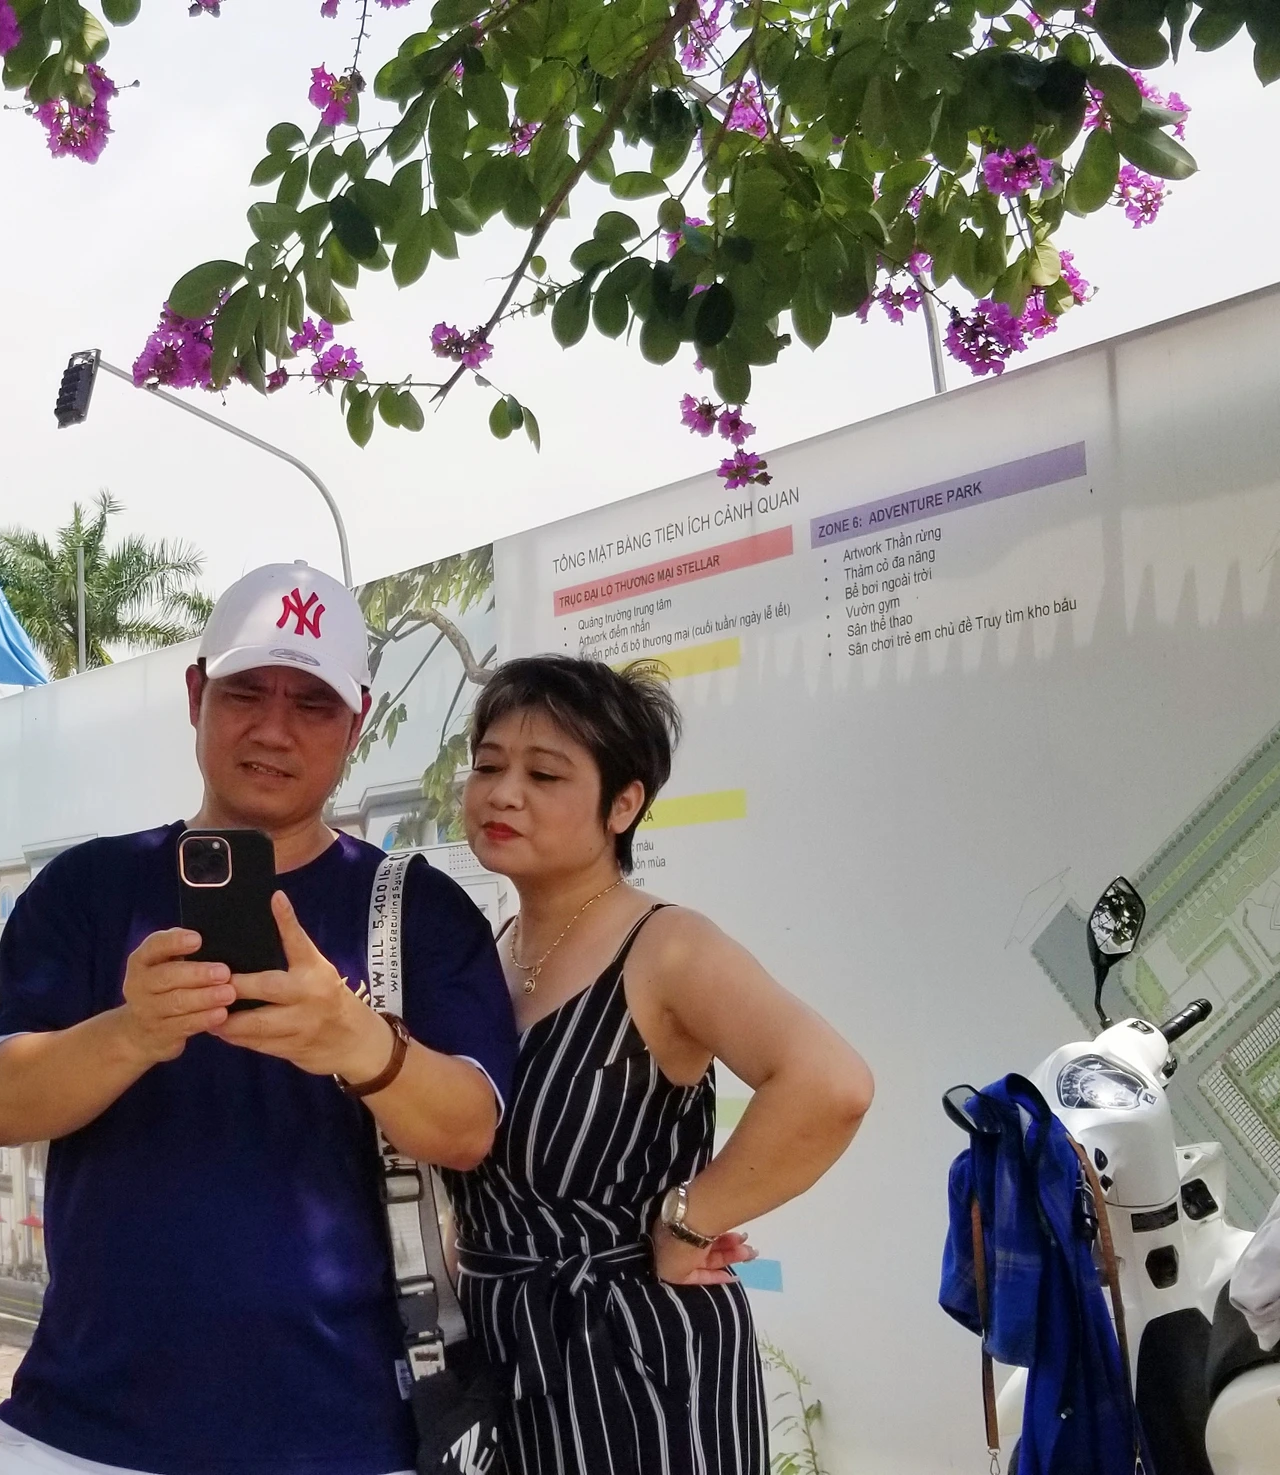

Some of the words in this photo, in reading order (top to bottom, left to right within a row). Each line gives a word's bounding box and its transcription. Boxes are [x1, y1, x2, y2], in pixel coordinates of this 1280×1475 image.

[654, 522, 684, 544] TIỆN
[688, 514, 710, 535] ÍCH
[714, 501, 753, 526] CẢNH
[757, 487, 799, 514] QUAN
[818, 518, 850, 539] ZONE
[852, 515, 863, 529] 6:
[868, 493, 943, 526] ADVENTURE
[946, 481, 983, 505] PARK
[843, 542, 882, 562] Artwork
[885, 532, 912, 551] Thần
[915, 528, 941, 544] rừng
[892, 556, 905, 569] đa
[908, 549, 935, 565] năng
[559, 592, 582, 610] TRỤC
[584, 589, 599, 603] ĐẠI
[614, 573, 655, 593] THƯƠNG
[657, 567, 674, 583] MẠI
[676, 554, 721, 577] STELLAR
[913, 567, 932, 583] trời
[276, 587, 326, 639] NY
[633, 603, 654, 617] trung
[656, 598, 672, 611] tâm
[846, 602, 875, 618] Vườn
[878, 597, 900, 614] gym
[579, 630, 607, 646] Artwork
[674, 627, 690, 642] mại
[739, 610, 762, 627] ngày
[847, 622, 867, 637] Sân
[870, 615, 886, 632] thể
[889, 614, 913, 628] thao
[848, 642, 868, 656] Sân
[871, 635, 894, 652] chơi
[897, 631, 911, 647] trẻ
[914, 630, 932, 643] em
[934, 621, 955, 639] chủ
[958, 615, 973, 633] đề
[975, 614, 1002, 629] Truy
[1005, 609, 1024, 624] tìm
[1027, 604, 1050, 620] kho
[1053, 598, 1077, 614] báu
